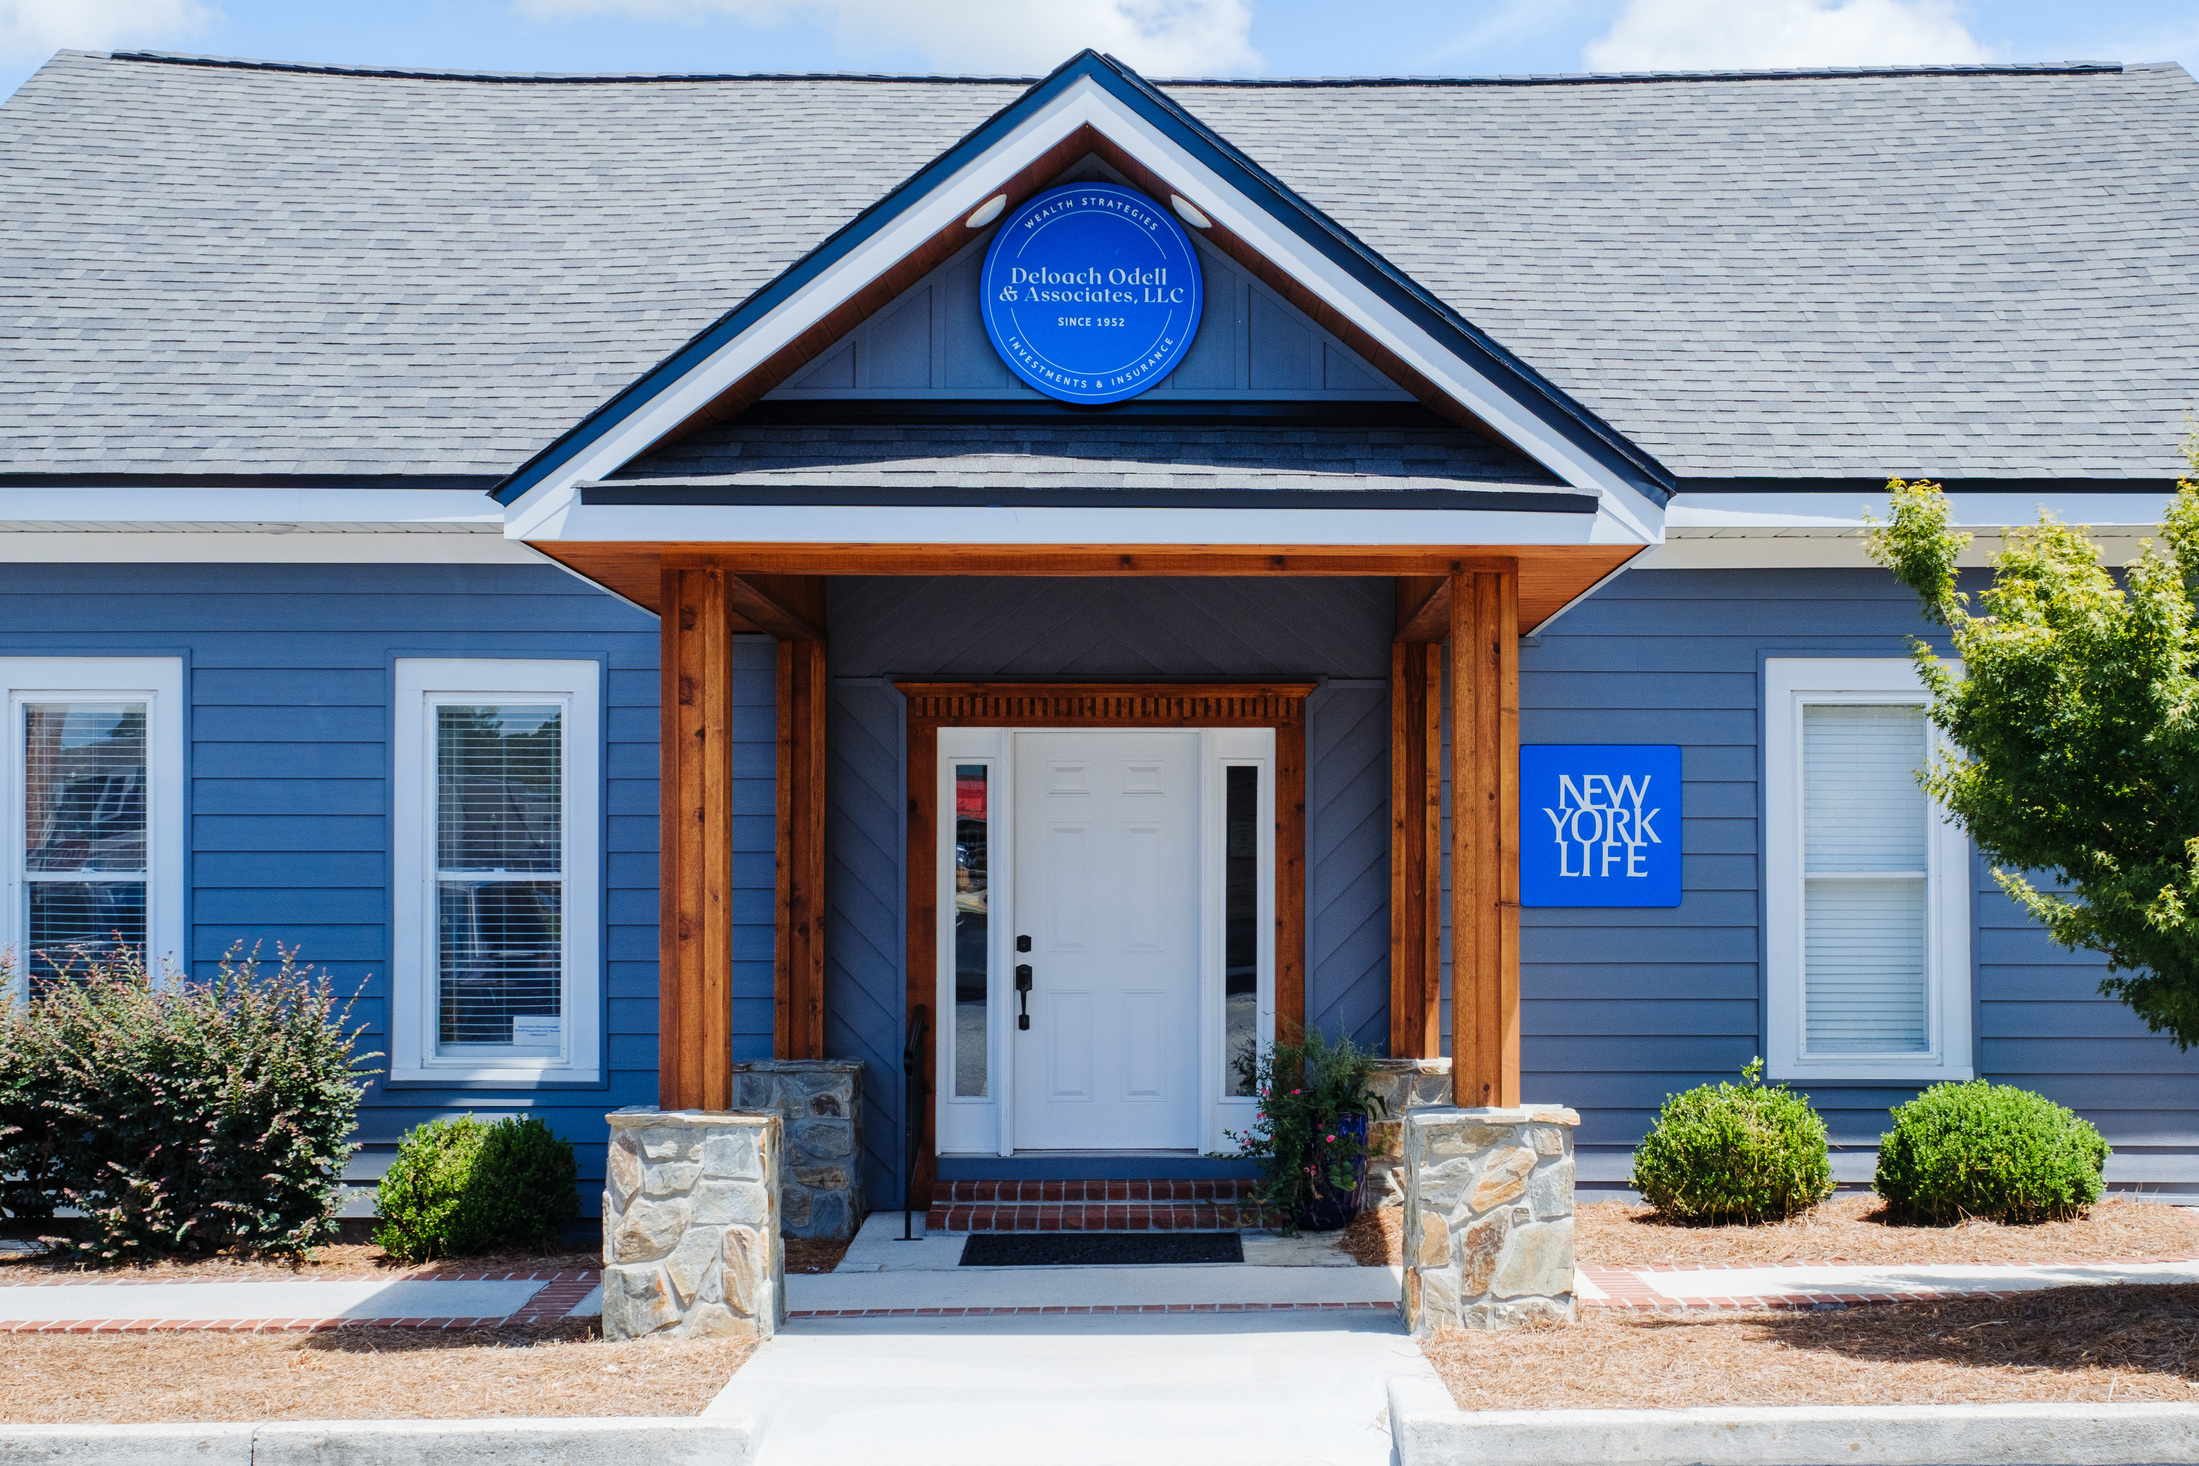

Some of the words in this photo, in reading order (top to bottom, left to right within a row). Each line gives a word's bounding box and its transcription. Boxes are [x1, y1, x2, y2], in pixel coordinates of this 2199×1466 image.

[1024, 200, 1074, 230] WEALTH
[1082, 197, 1158, 231] STRATEGIES
[1011, 266, 1102, 285] Deloach
[1108, 267, 1167, 286] Odell
[999, 285, 1018, 302] &
[1024, 286, 1138, 305] Associates,
[1144, 287, 1184, 303] LLC
[1058, 317, 1092, 327] SINCE
[1096, 317, 1125, 327] 1952
[1009, 336, 1088, 389] INVESTMENTS
[1095, 380, 1104, 389] &
[1111, 336, 1174, 387] INSURANCE
[1558, 774, 1652, 810] NEW
[1542, 807, 1663, 844] YORK
[1559, 841, 1649, 878] LIFE
